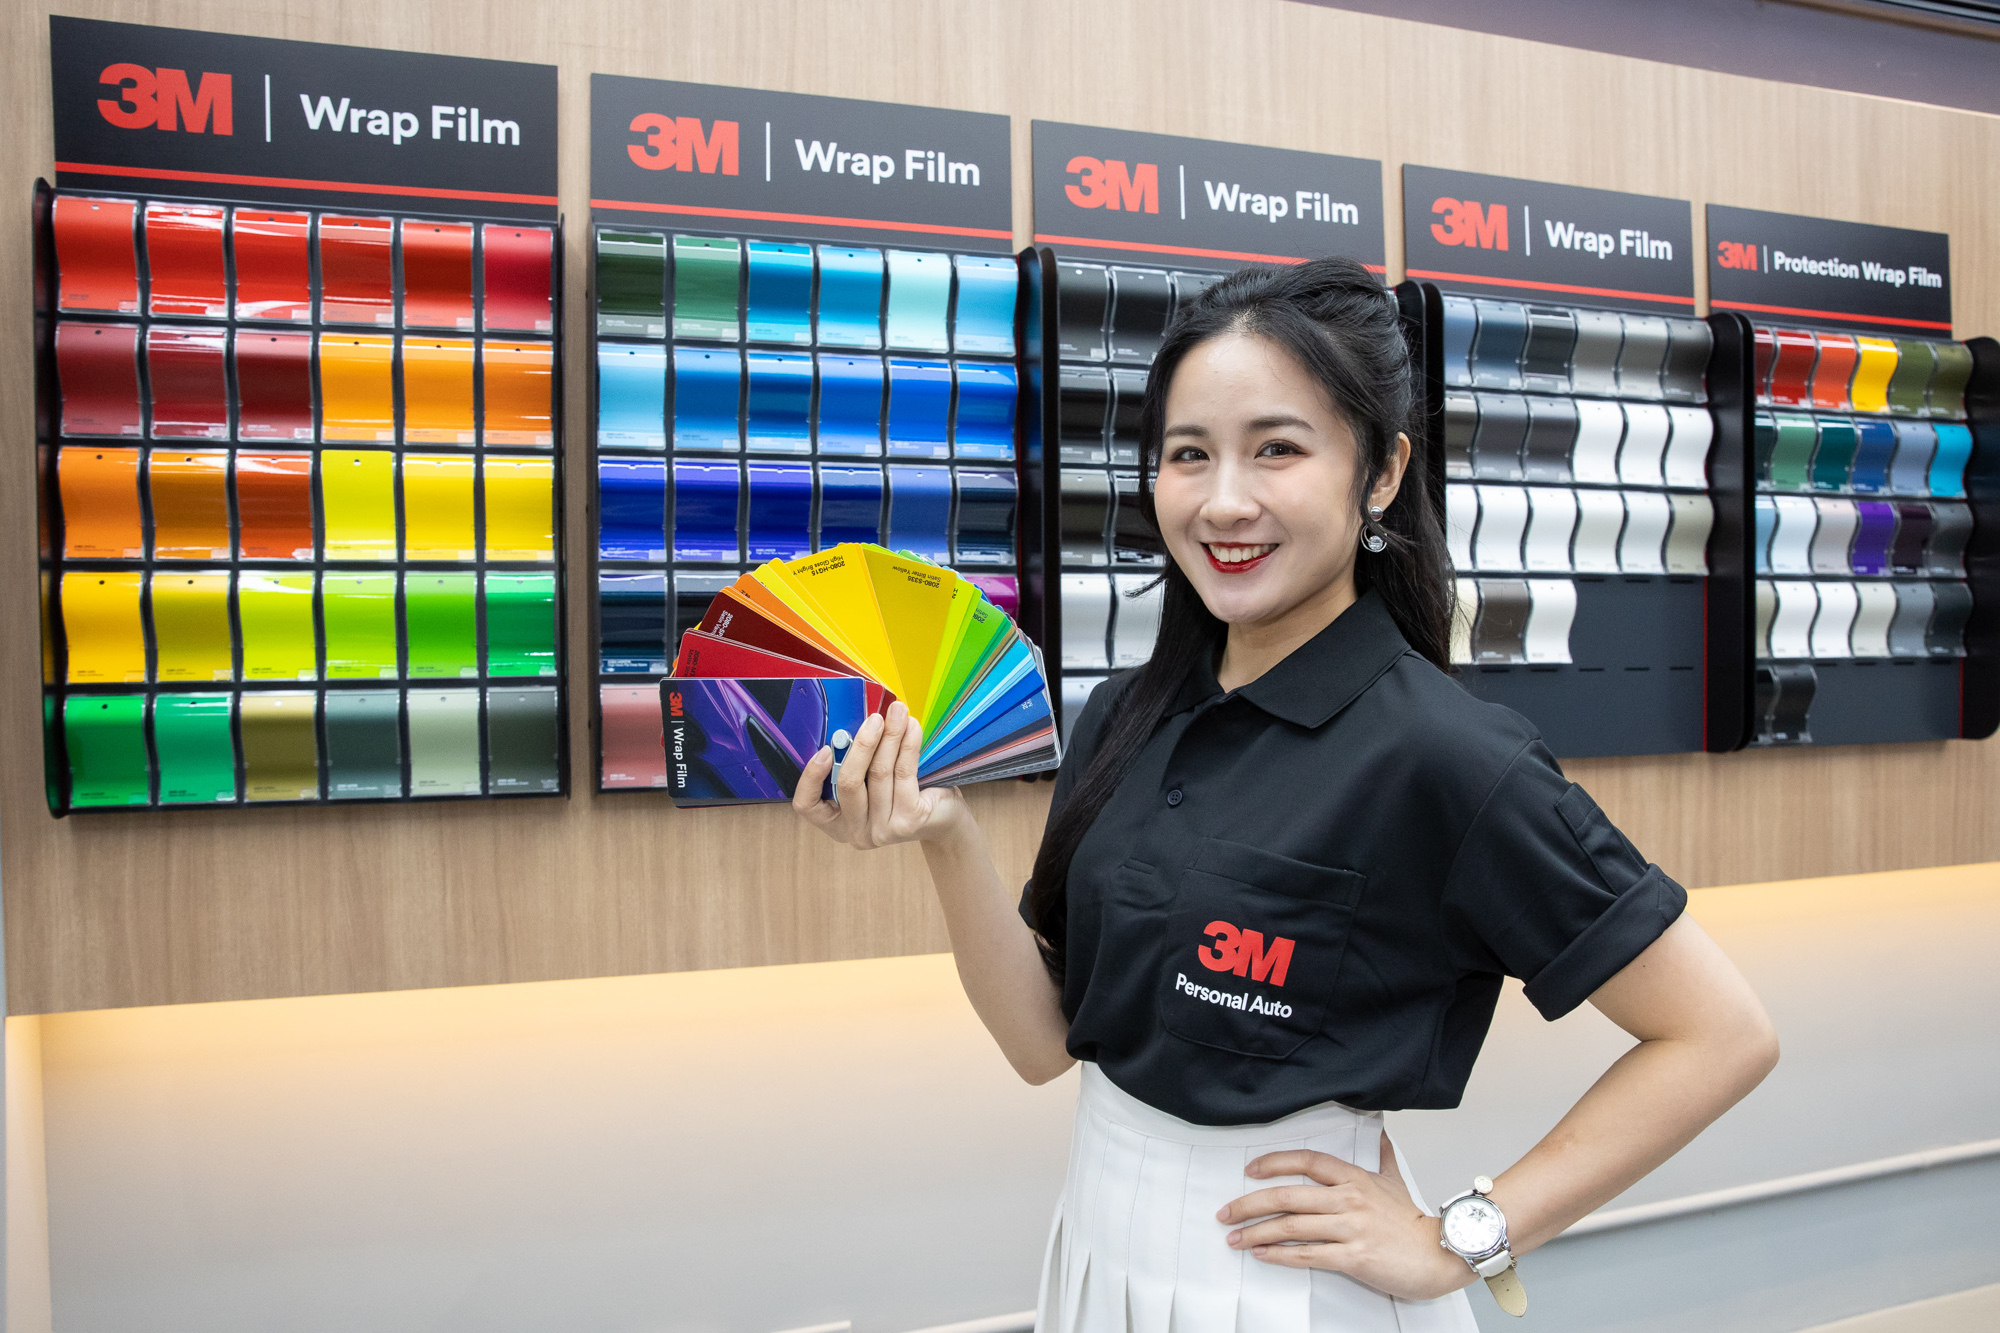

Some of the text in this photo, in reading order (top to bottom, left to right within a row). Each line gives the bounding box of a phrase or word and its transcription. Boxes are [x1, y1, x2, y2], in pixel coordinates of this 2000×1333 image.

[97, 63, 521, 146] 3M Wrap Film
[627, 112, 980, 187] 3M Wrap Film
[1064, 156, 1359, 225] 3M Wrap Film
[1430, 196, 1673, 261] 3M Wrap Film
[1717, 240, 1942, 289] 3M Protection Wrap Film
[797, 564, 814, 573] Bright
[814, 560, 829, 568] Gloss
[830, 555, 844, 563] High
[892, 565, 941, 582] Satin Bitter Yellow
[669, 692, 687, 788] 3M Wrap Film
[1197, 920, 1296, 987] 3M
[1175, 972, 1293, 1018] Personal Auto
